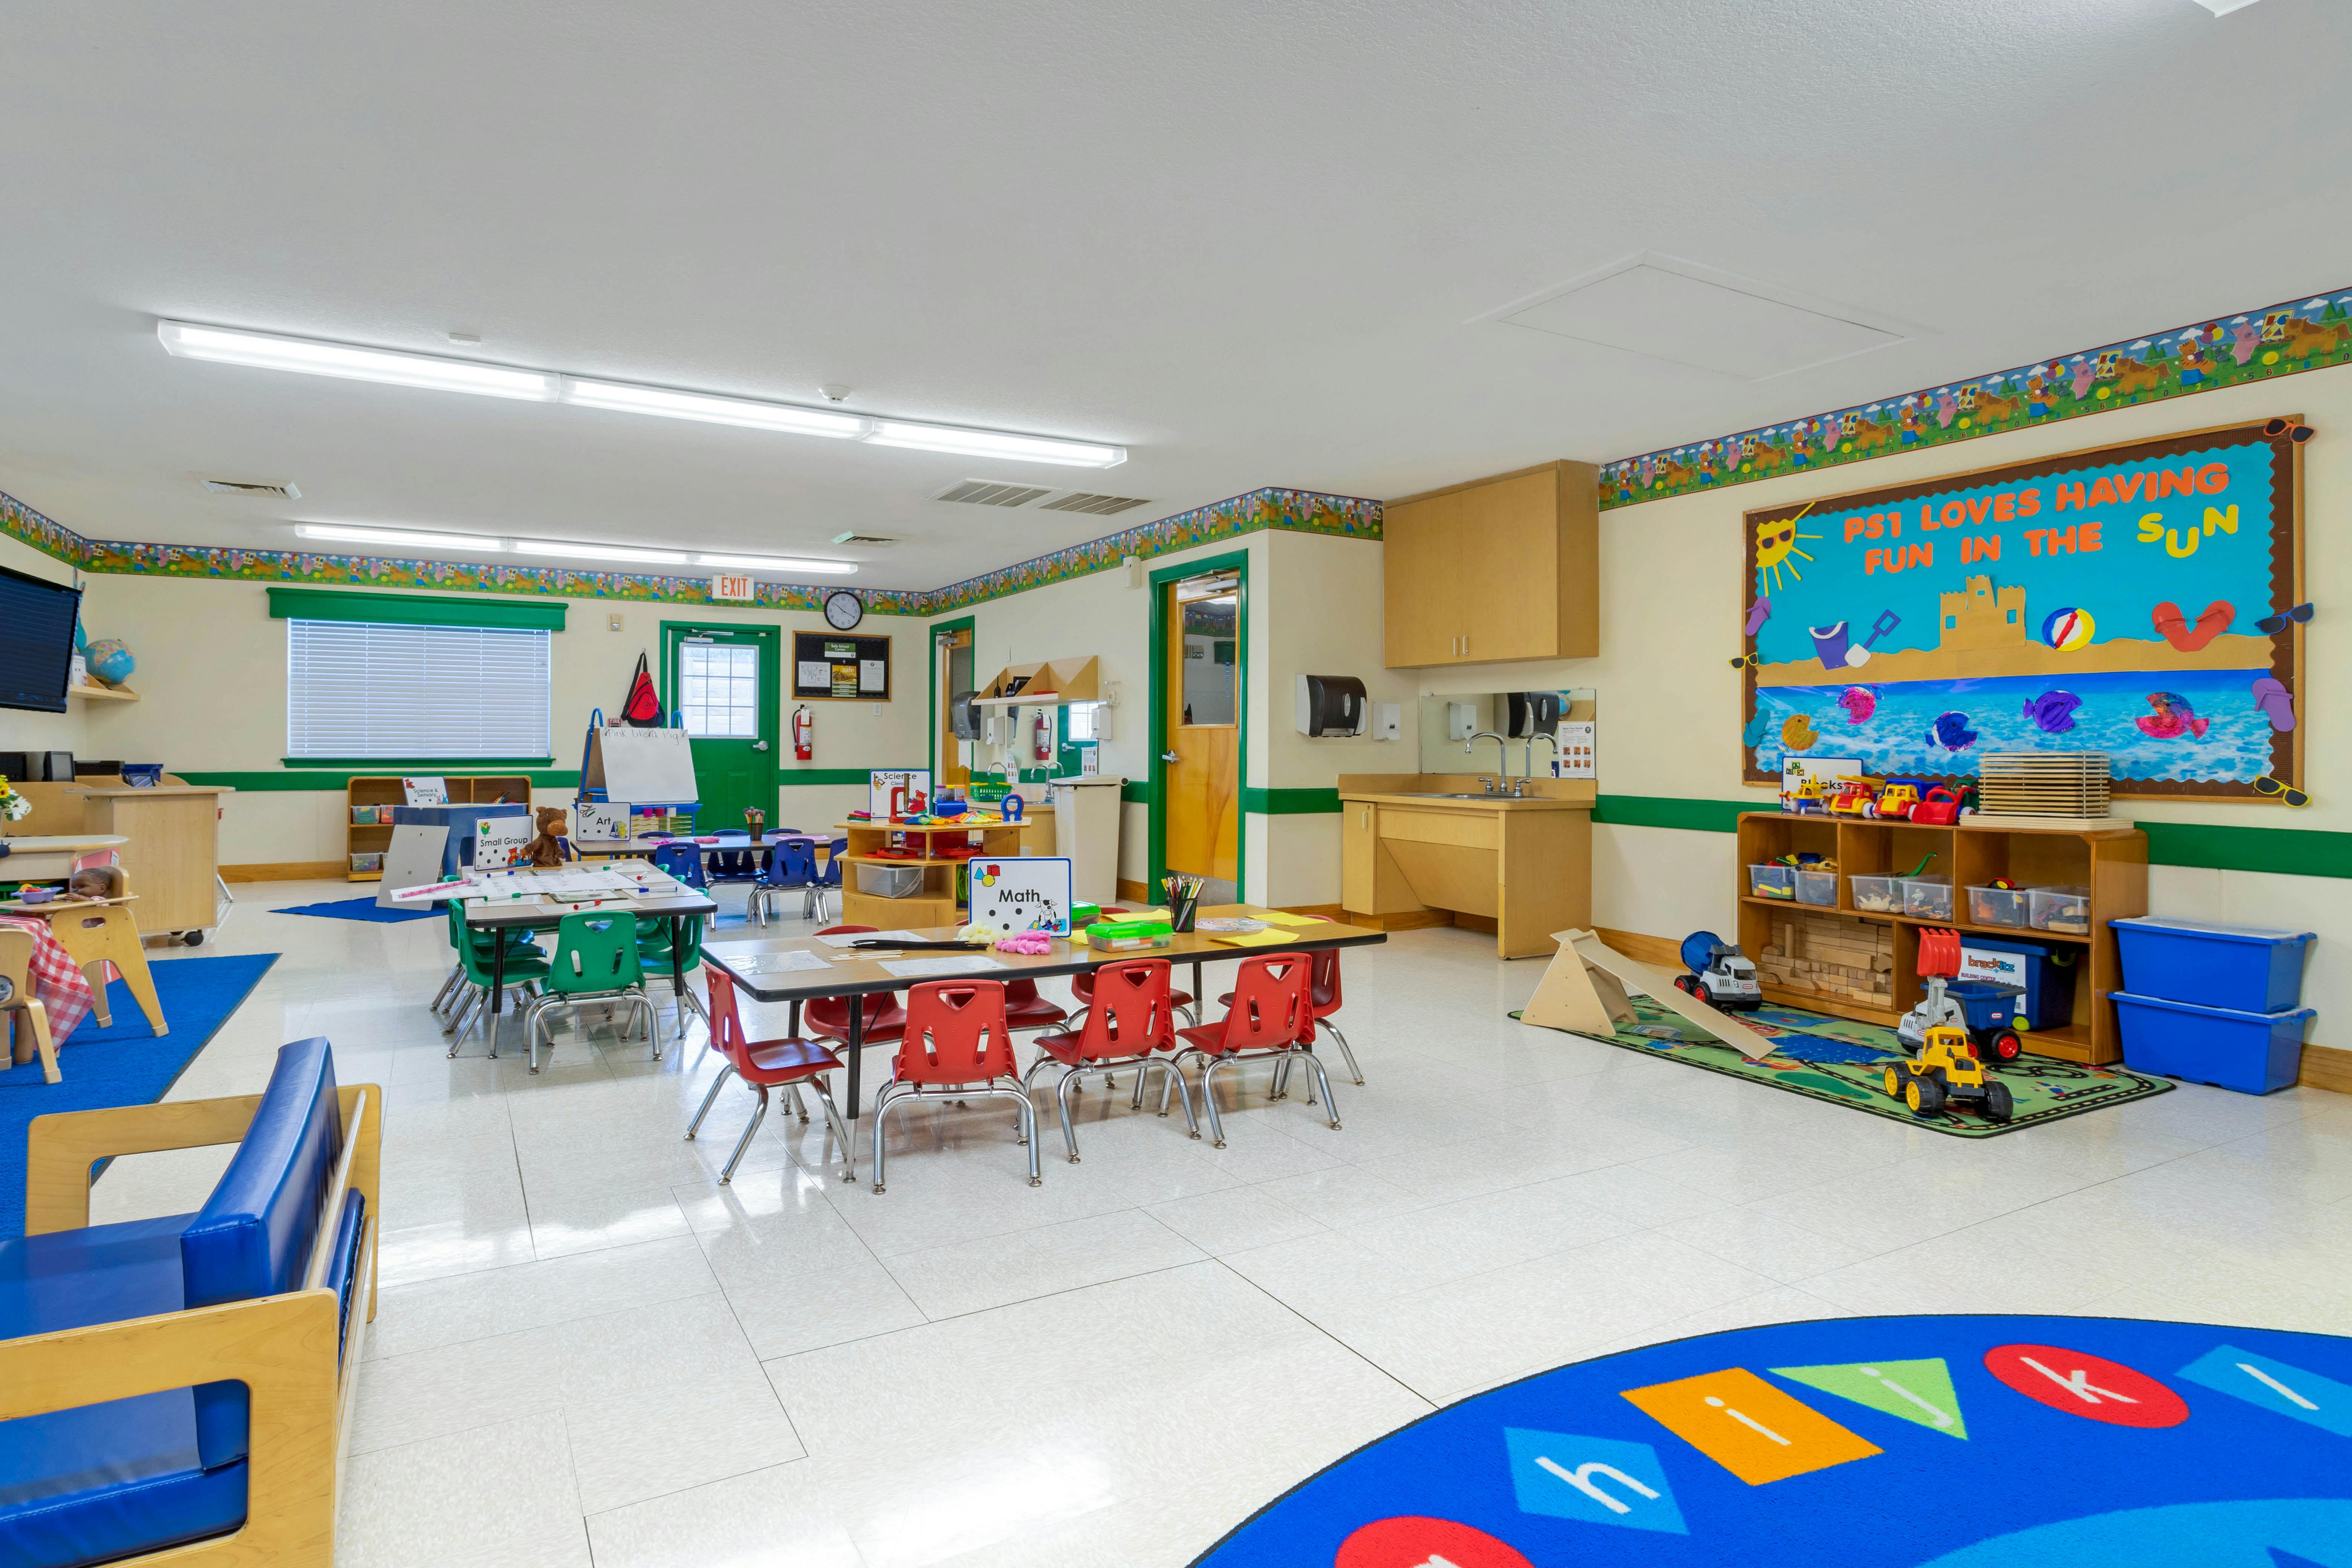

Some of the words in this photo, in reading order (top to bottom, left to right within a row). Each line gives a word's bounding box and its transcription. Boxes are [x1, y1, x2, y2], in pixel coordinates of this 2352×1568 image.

[2196, 382, 2202, 391] 2
[2248, 372, 2254, 380] 5
[1844, 512, 1901, 544] PS1
[1920, 489, 2040, 531] LOVES
[2055, 463, 2229, 511] HAVING
[1865, 542, 1933, 576] FUN
[1960, 535, 2000, 564] IN
[2023, 522, 2102, 557] THE
[2137, 504, 2239, 558] SUN
[721, 577, 748, 597] EXIT
[607, 729, 627, 737] Pink
[663, 730, 679, 745] Pig
[480, 838, 502, 847] Small
[504, 837, 528, 846] Group
[999, 889, 1040, 902] Math
[1968, 955, 2015, 972] brackitz
[2019, 1357, 2142, 1404] k
[1860, 1367, 1954, 1429] j
[1704, 1395, 1791, 1446] i
[1536, 1456, 1660, 1513] h
